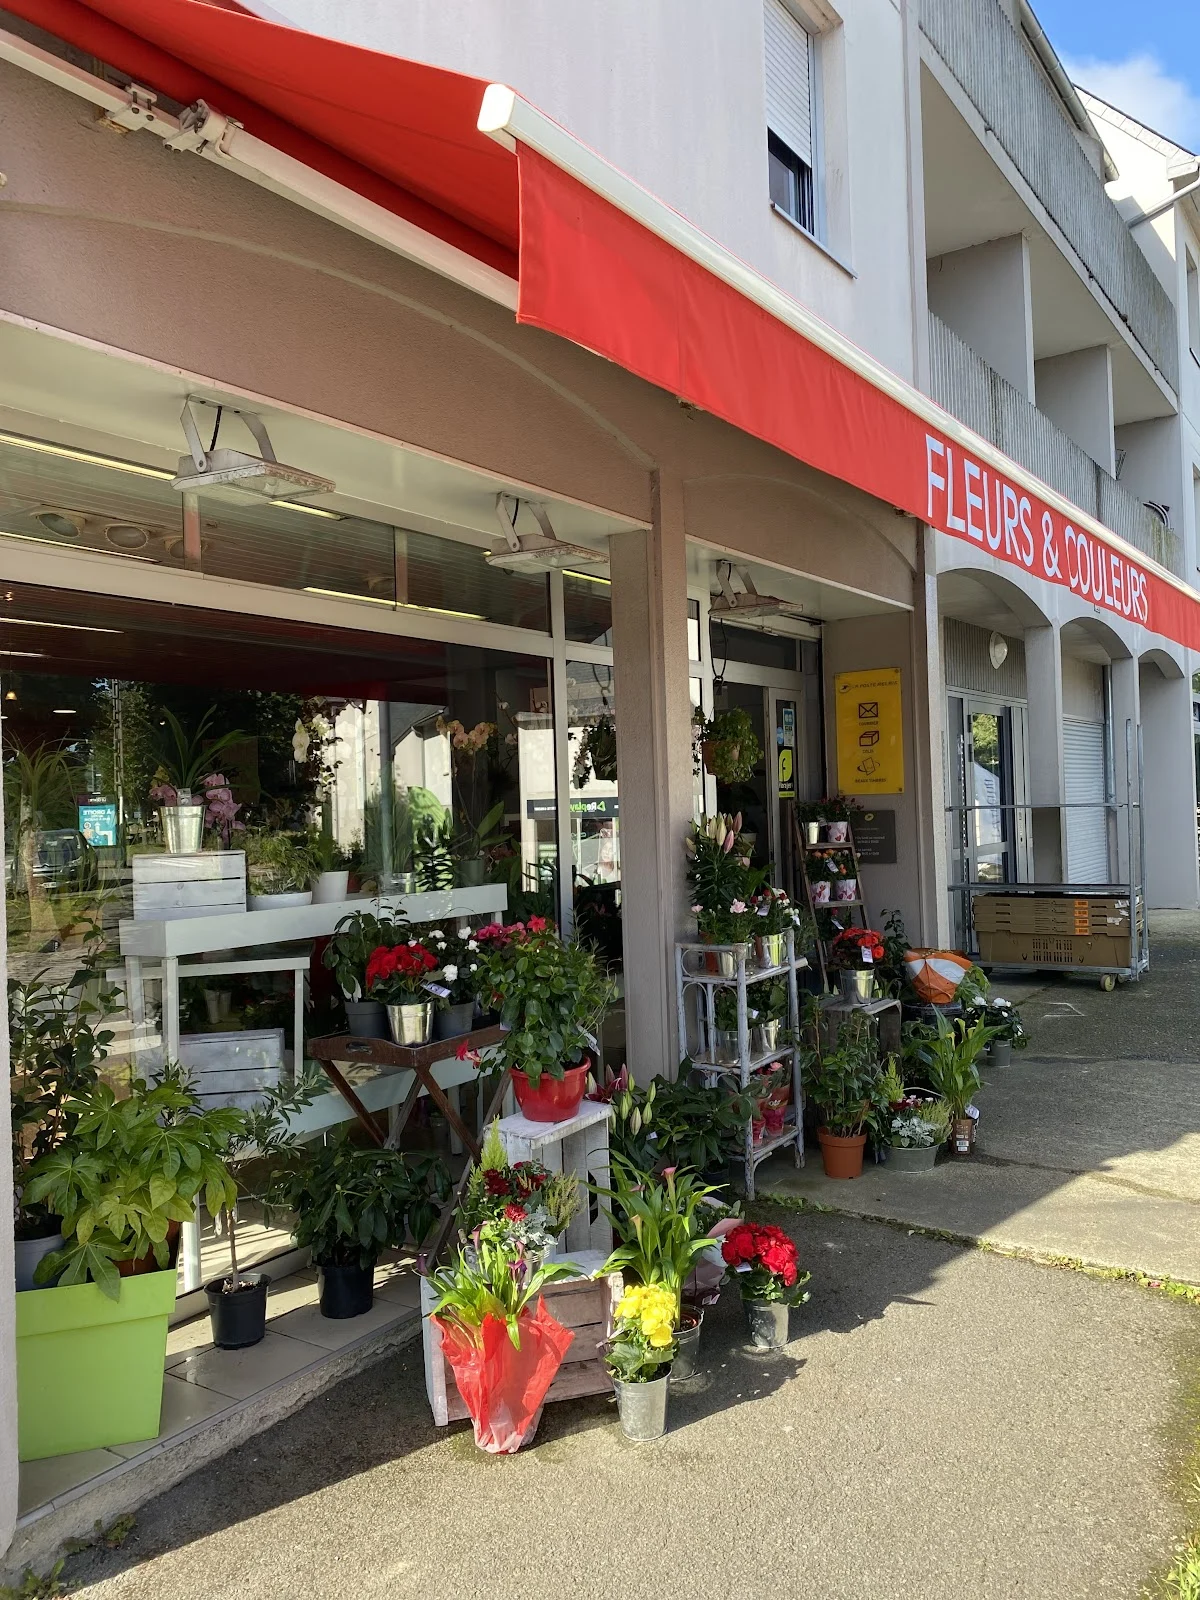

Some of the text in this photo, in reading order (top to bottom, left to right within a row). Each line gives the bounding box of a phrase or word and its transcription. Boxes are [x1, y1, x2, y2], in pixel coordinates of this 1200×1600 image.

[926, 434, 1148, 624] FLEURS & COULEURS
